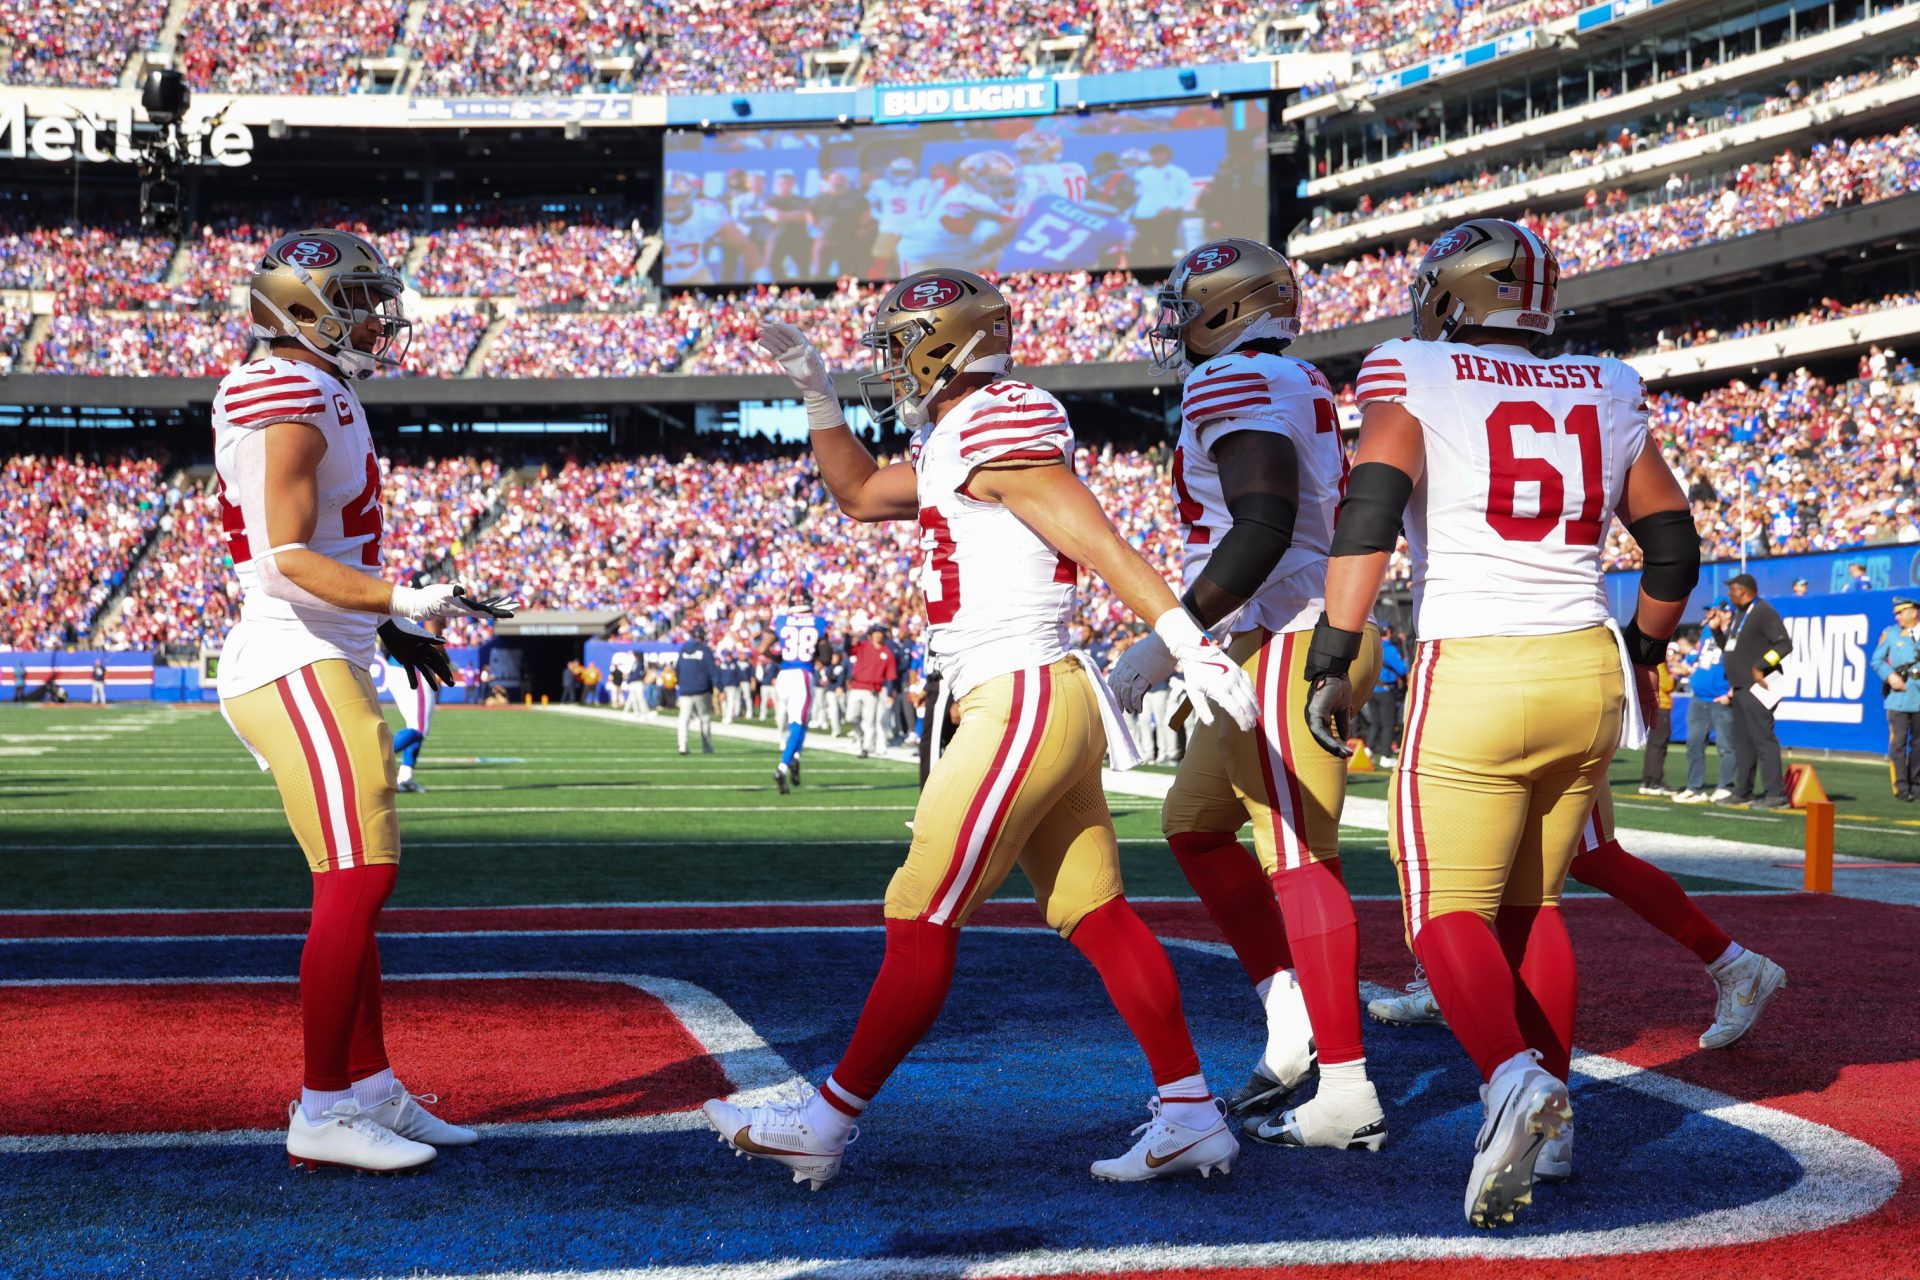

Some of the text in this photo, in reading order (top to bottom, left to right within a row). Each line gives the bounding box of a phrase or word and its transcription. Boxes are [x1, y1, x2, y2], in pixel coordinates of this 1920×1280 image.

[883, 83, 1046, 117] BUD LIGHT
[1014, 213, 1091, 263] 51
[1450, 353, 1604, 390] HENNESSY
[1485, 400, 1605, 546] 61
[780, 626, 819, 662] 38
[1783, 613, 1869, 700] ANTS
